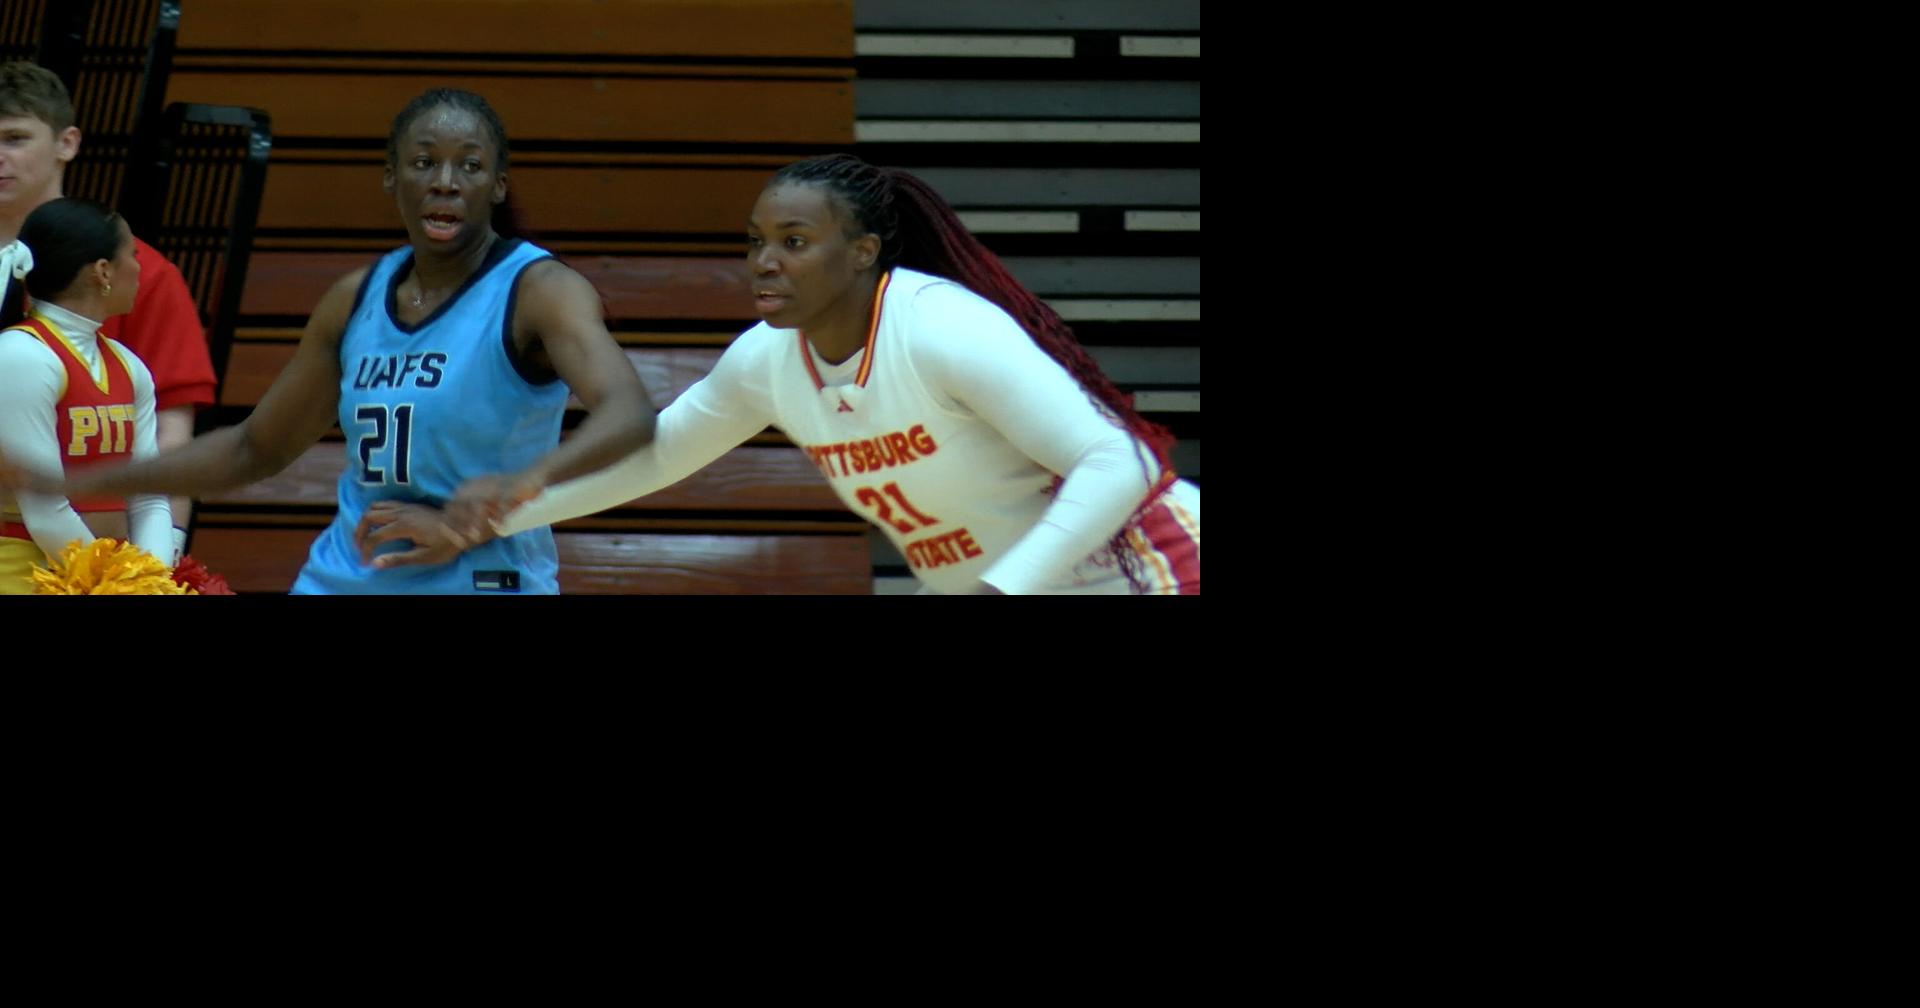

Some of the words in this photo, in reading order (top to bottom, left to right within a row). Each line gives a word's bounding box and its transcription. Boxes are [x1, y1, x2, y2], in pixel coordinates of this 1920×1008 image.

[352, 352, 448, 390] UAFS
[355, 402, 414, 487] 21
[807, 424, 938, 478] TTSBURG
[855, 481, 941, 534] 21
